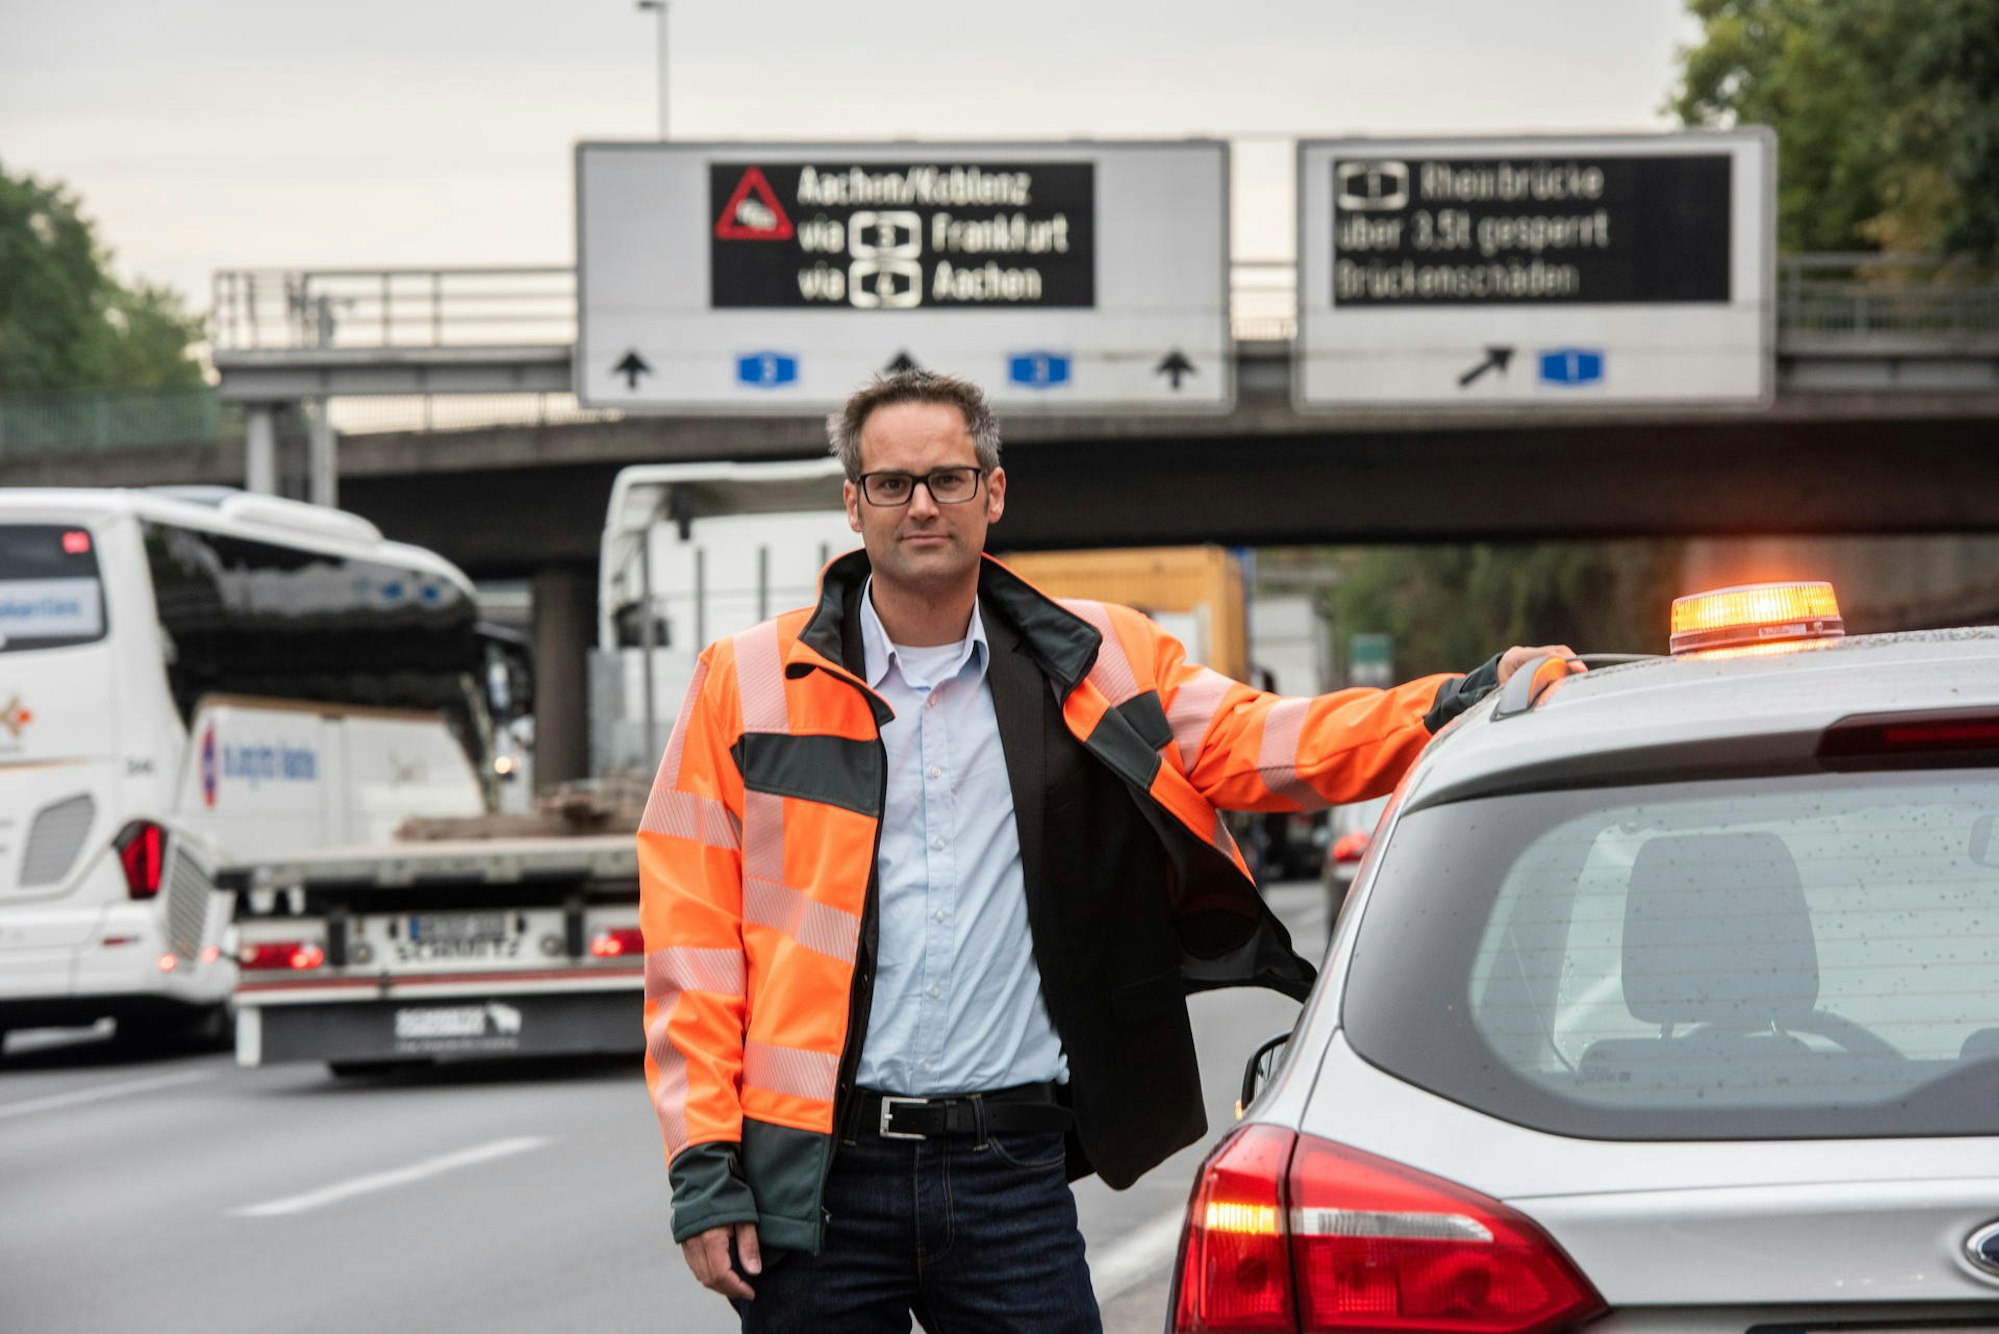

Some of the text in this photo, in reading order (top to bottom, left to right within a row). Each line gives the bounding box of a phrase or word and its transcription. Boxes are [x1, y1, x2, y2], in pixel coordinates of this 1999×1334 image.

[798, 165, 1031, 205] Aachen/Koblenz
[1420, 160, 1604, 201] Rheinbrücke
[798, 212, 845, 253] via
[932, 212, 1069, 253] Frankfurt
[1335, 210, 1404, 252] über
[1477, 209, 1610, 258] gesperrt
[798, 260, 845, 301] via
[932, 260, 1042, 301] Aachen
